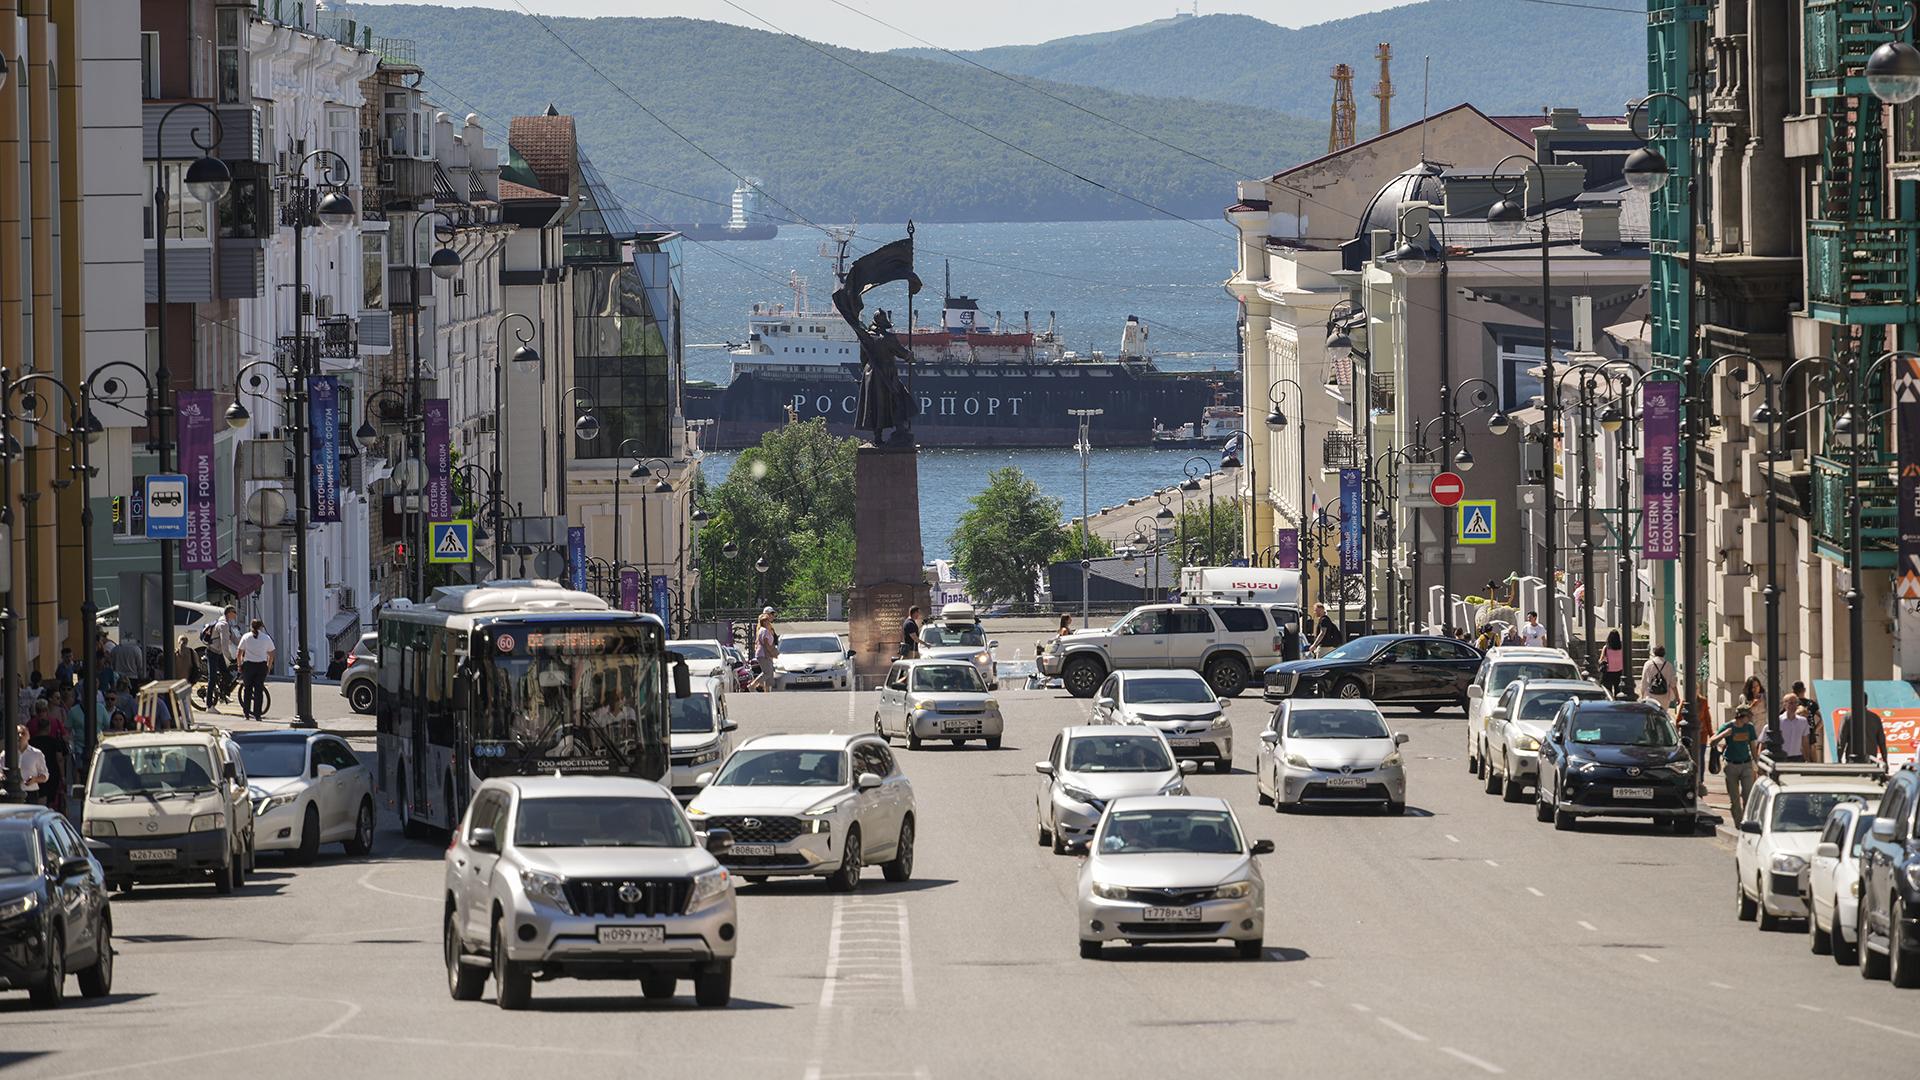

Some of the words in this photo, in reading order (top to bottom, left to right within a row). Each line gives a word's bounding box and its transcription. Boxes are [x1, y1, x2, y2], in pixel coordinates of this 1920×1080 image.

[325, 408, 333, 440] ФОРУМ
[793, 394, 1023, 416] РОСРПОРТ
[198, 455, 209, 497] FORUM
[325, 440, 335, 517] ЭКОНОМИЧЕСКИЙ
[1662, 445, 1673, 488] FORUM
[316, 463, 326, 517] ВОСТОЧНЫЙ
[431, 481, 439, 518] EASTERN
[440, 475, 448, 518] ECONOMIC
[187, 511, 198, 563] EASTERN
[199, 501, 212, 563] ECONOMIC
[1648, 500, 1660, 553] EASTERN
[1662, 491, 1673, 552] ECONOMIC
[1231, 582, 1279, 590] ISUZU
[499, 637, 512, 648] 60
